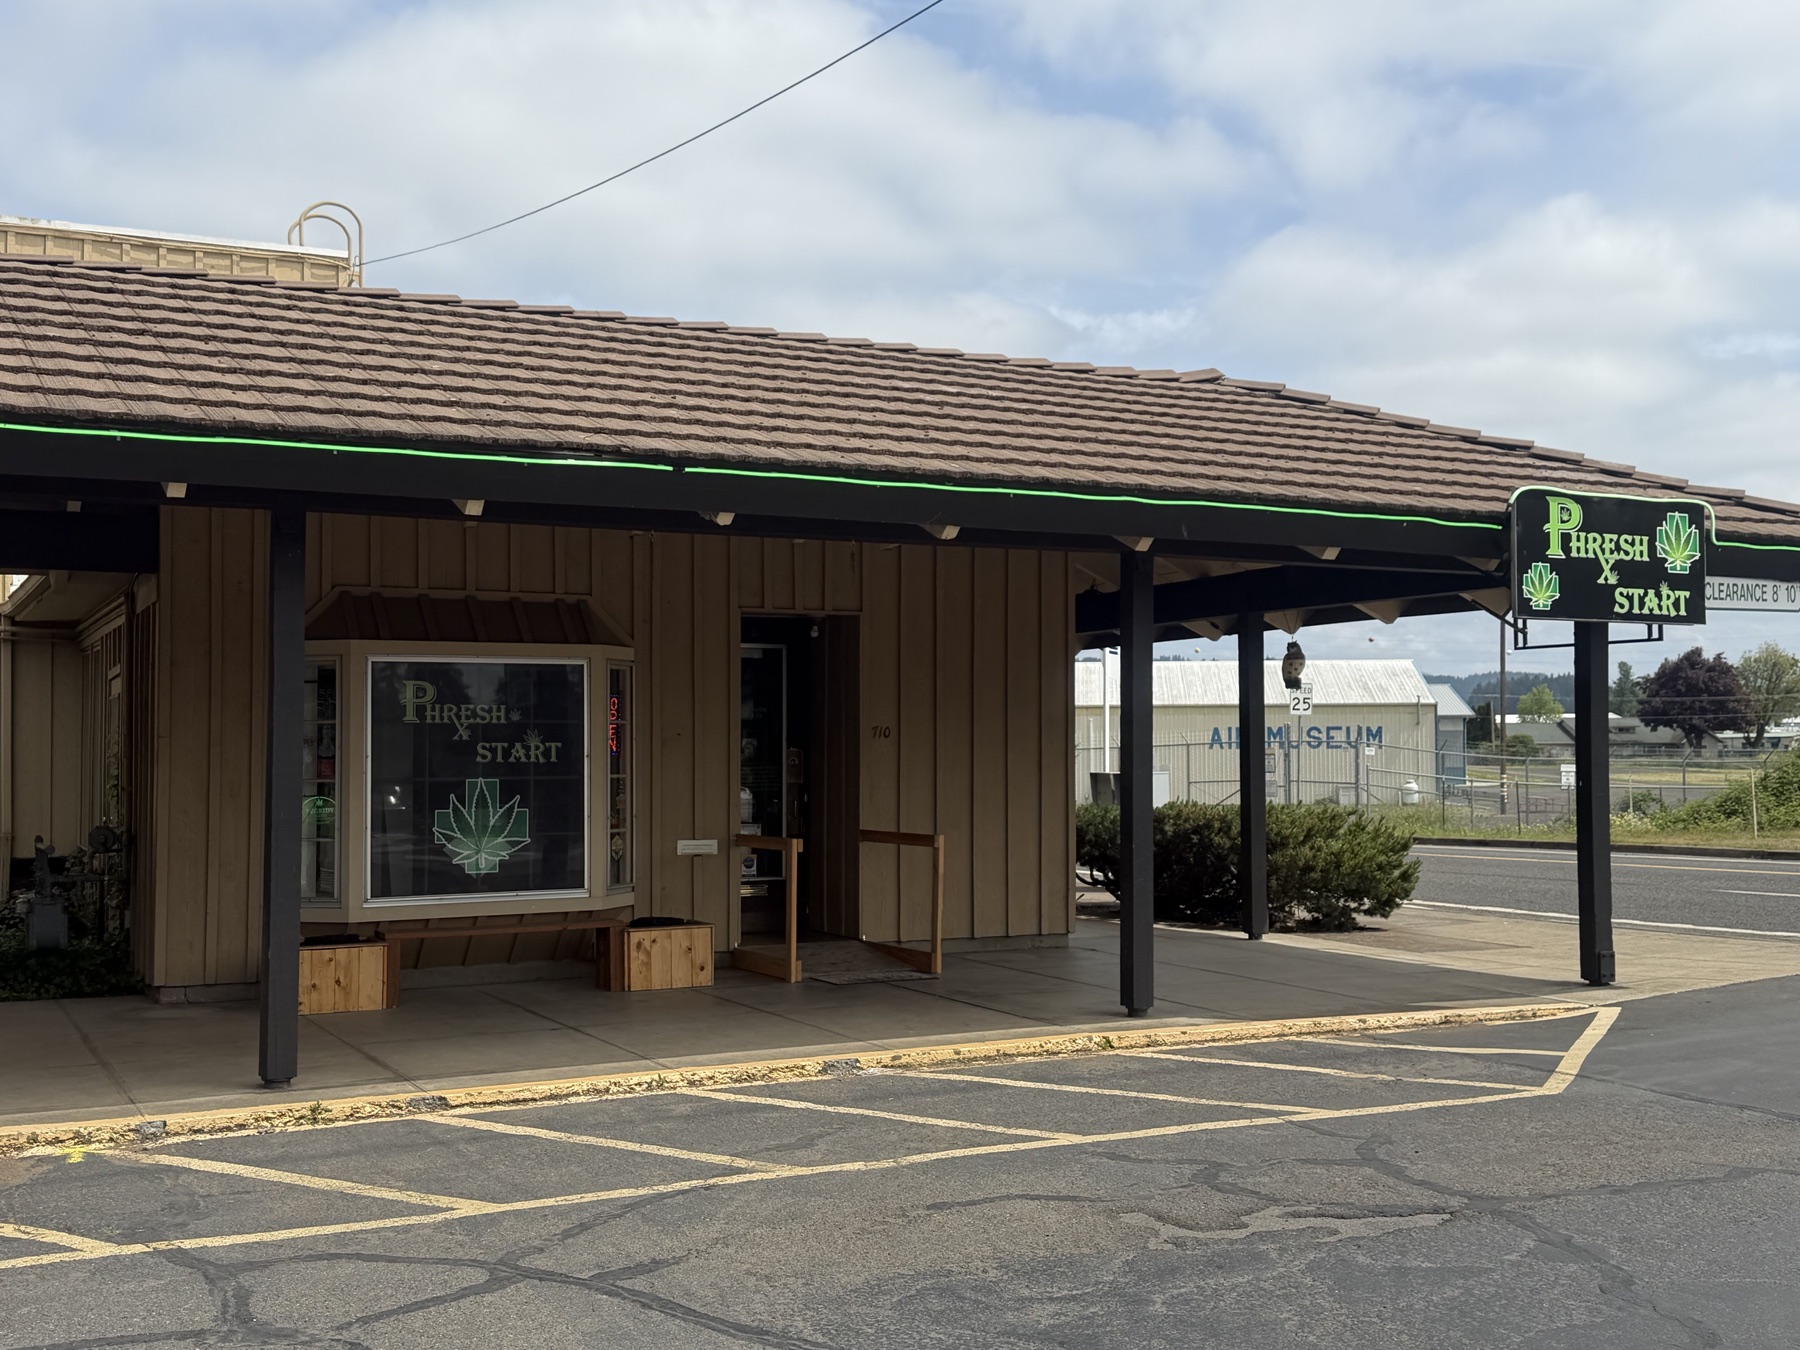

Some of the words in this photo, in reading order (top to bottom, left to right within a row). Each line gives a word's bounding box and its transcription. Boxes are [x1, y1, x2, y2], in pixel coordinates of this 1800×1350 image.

[1613, 587, 1690, 617] START
[1705, 582, 1768, 602] CLEARANCE
[1292, 697, 1311, 711] 25
[871, 725, 891, 740] 710
[475, 742, 562, 764] START
